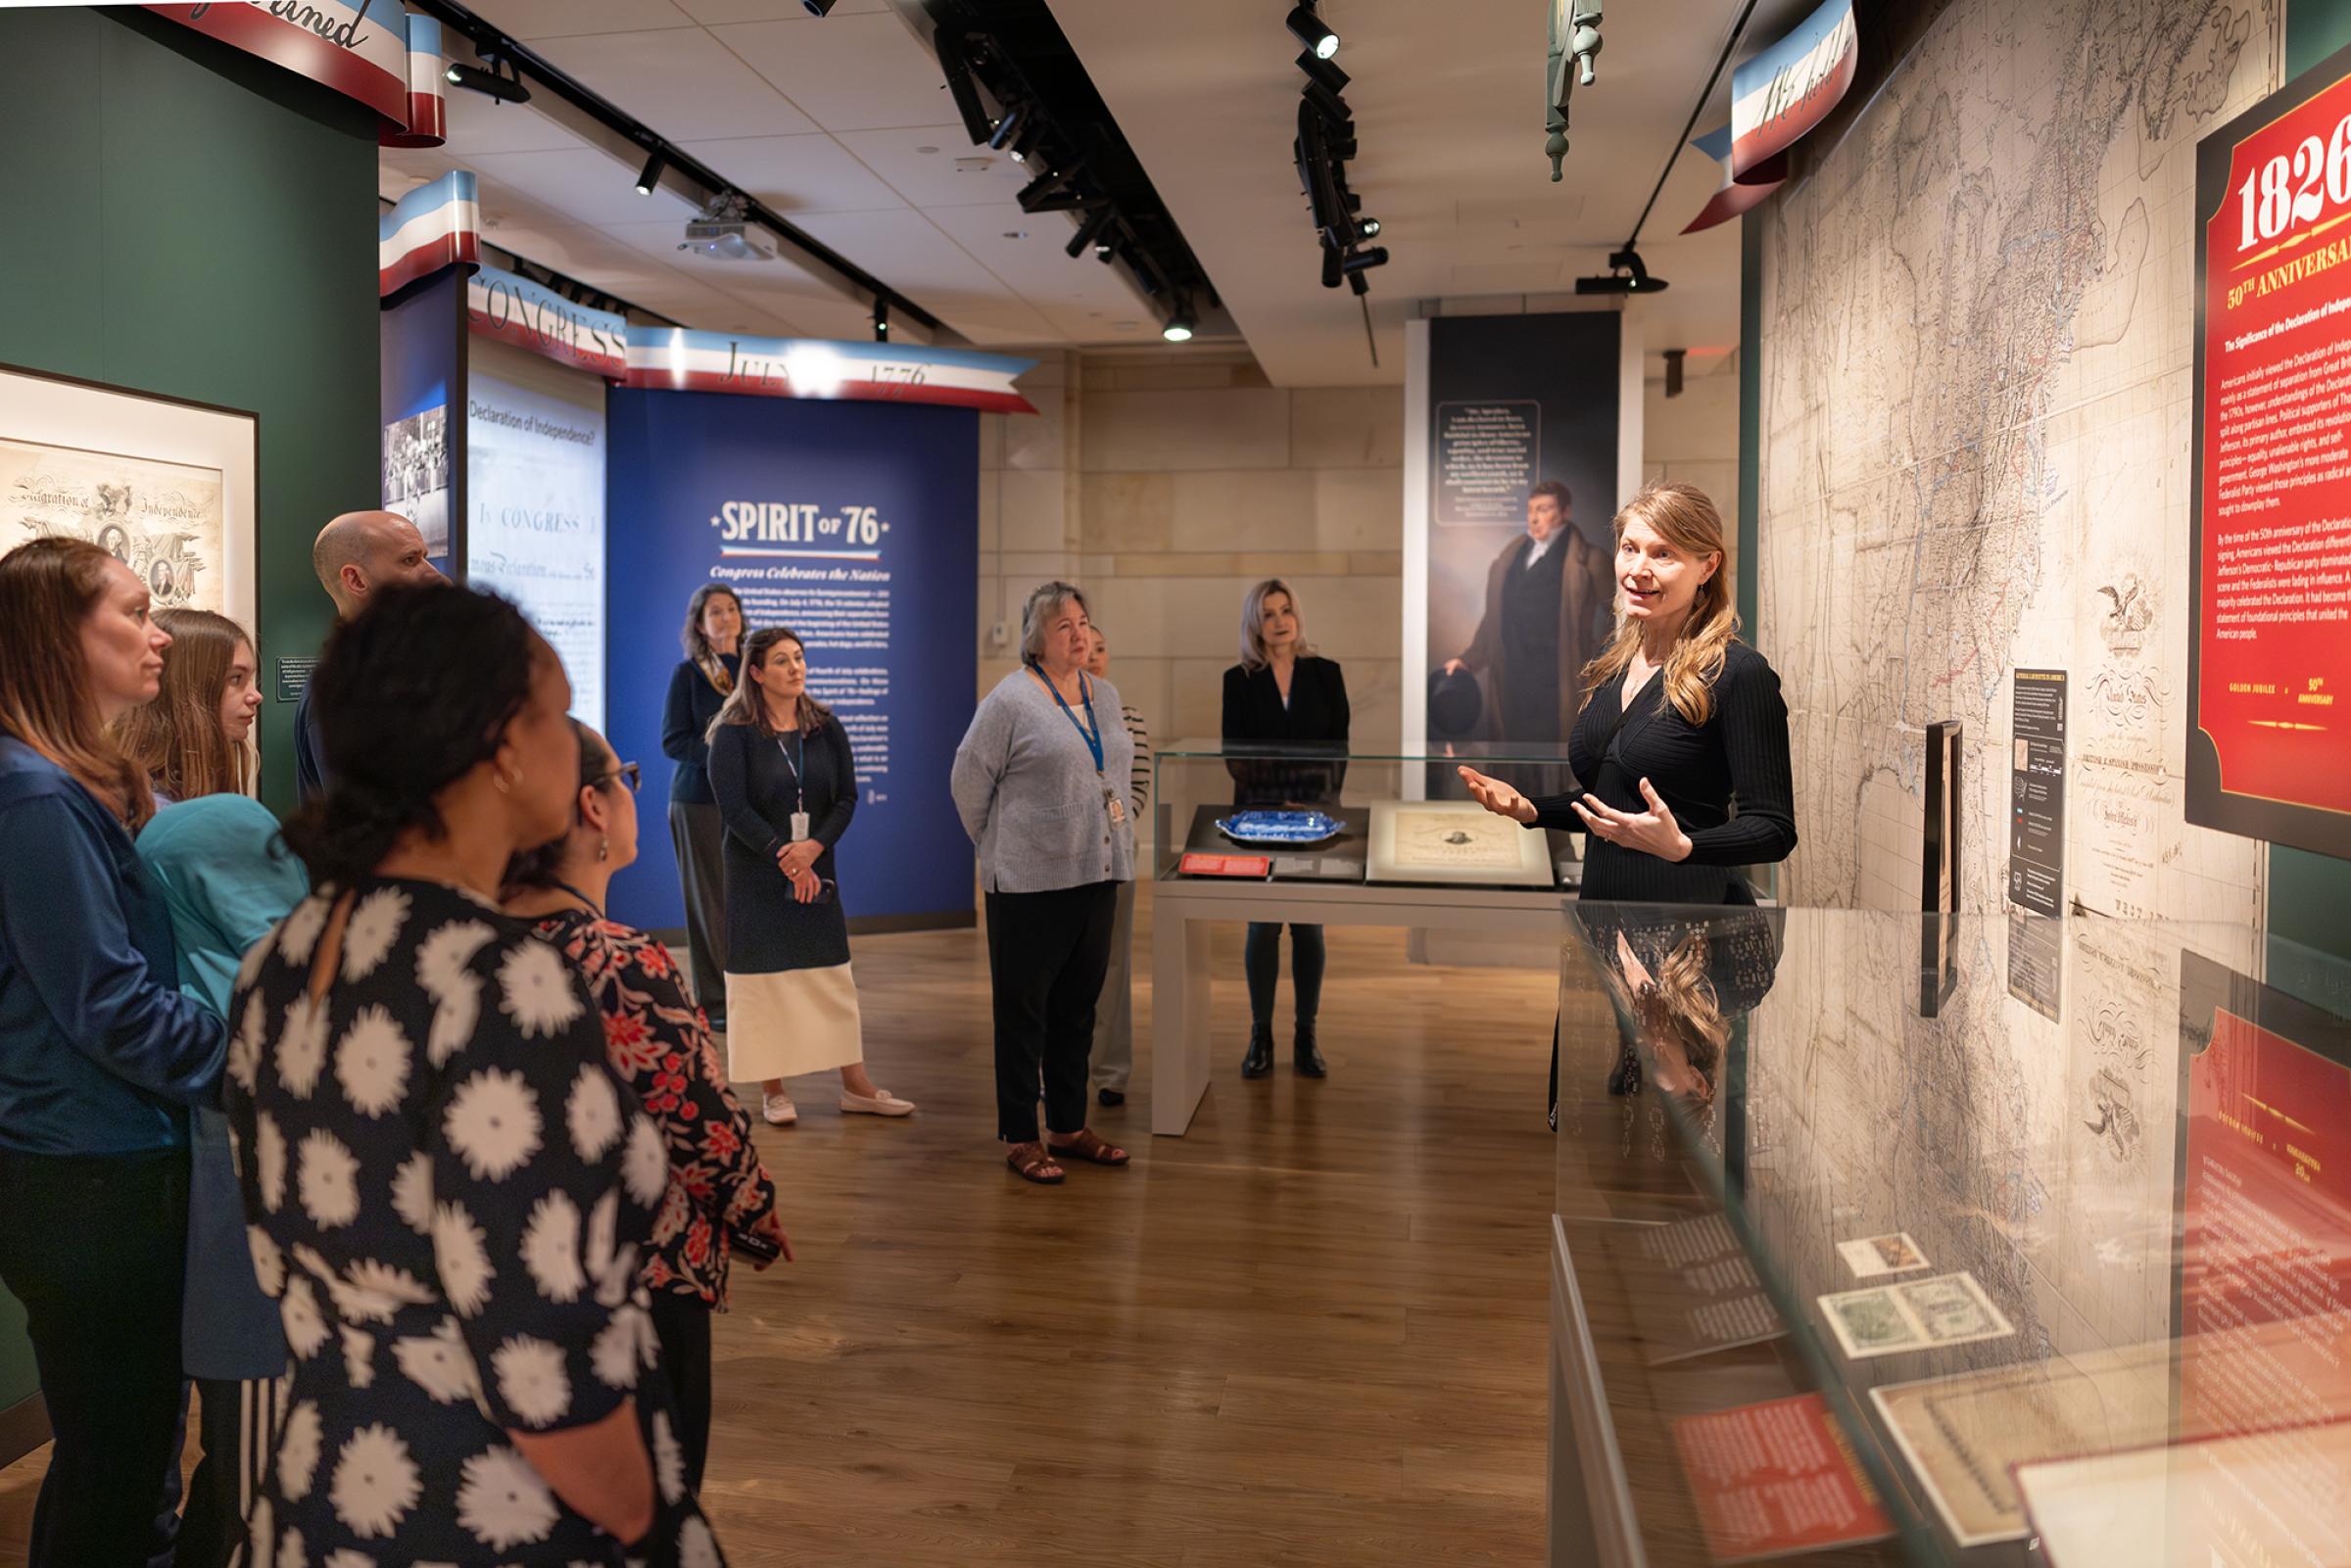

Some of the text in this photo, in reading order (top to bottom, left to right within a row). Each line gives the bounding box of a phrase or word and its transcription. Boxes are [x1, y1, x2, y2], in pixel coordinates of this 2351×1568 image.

[2237, 115, 2351, 252] 1826
[2228, 277, 2255, 309] 50TH
[468, 272, 627, 367] CONGRESS
[470, 400, 596, 445] Declaration of Independence?
[721, 500, 819, 542] SPIRIT
[818, 518, 841, 535] OF
[710, 566, 890, 582] Congress Celebrates the Nation
[2230, 683, 2276, 694] GOLDEN JUBILEE
[2298, 693, 2333, 705] ANNIVERSARY
